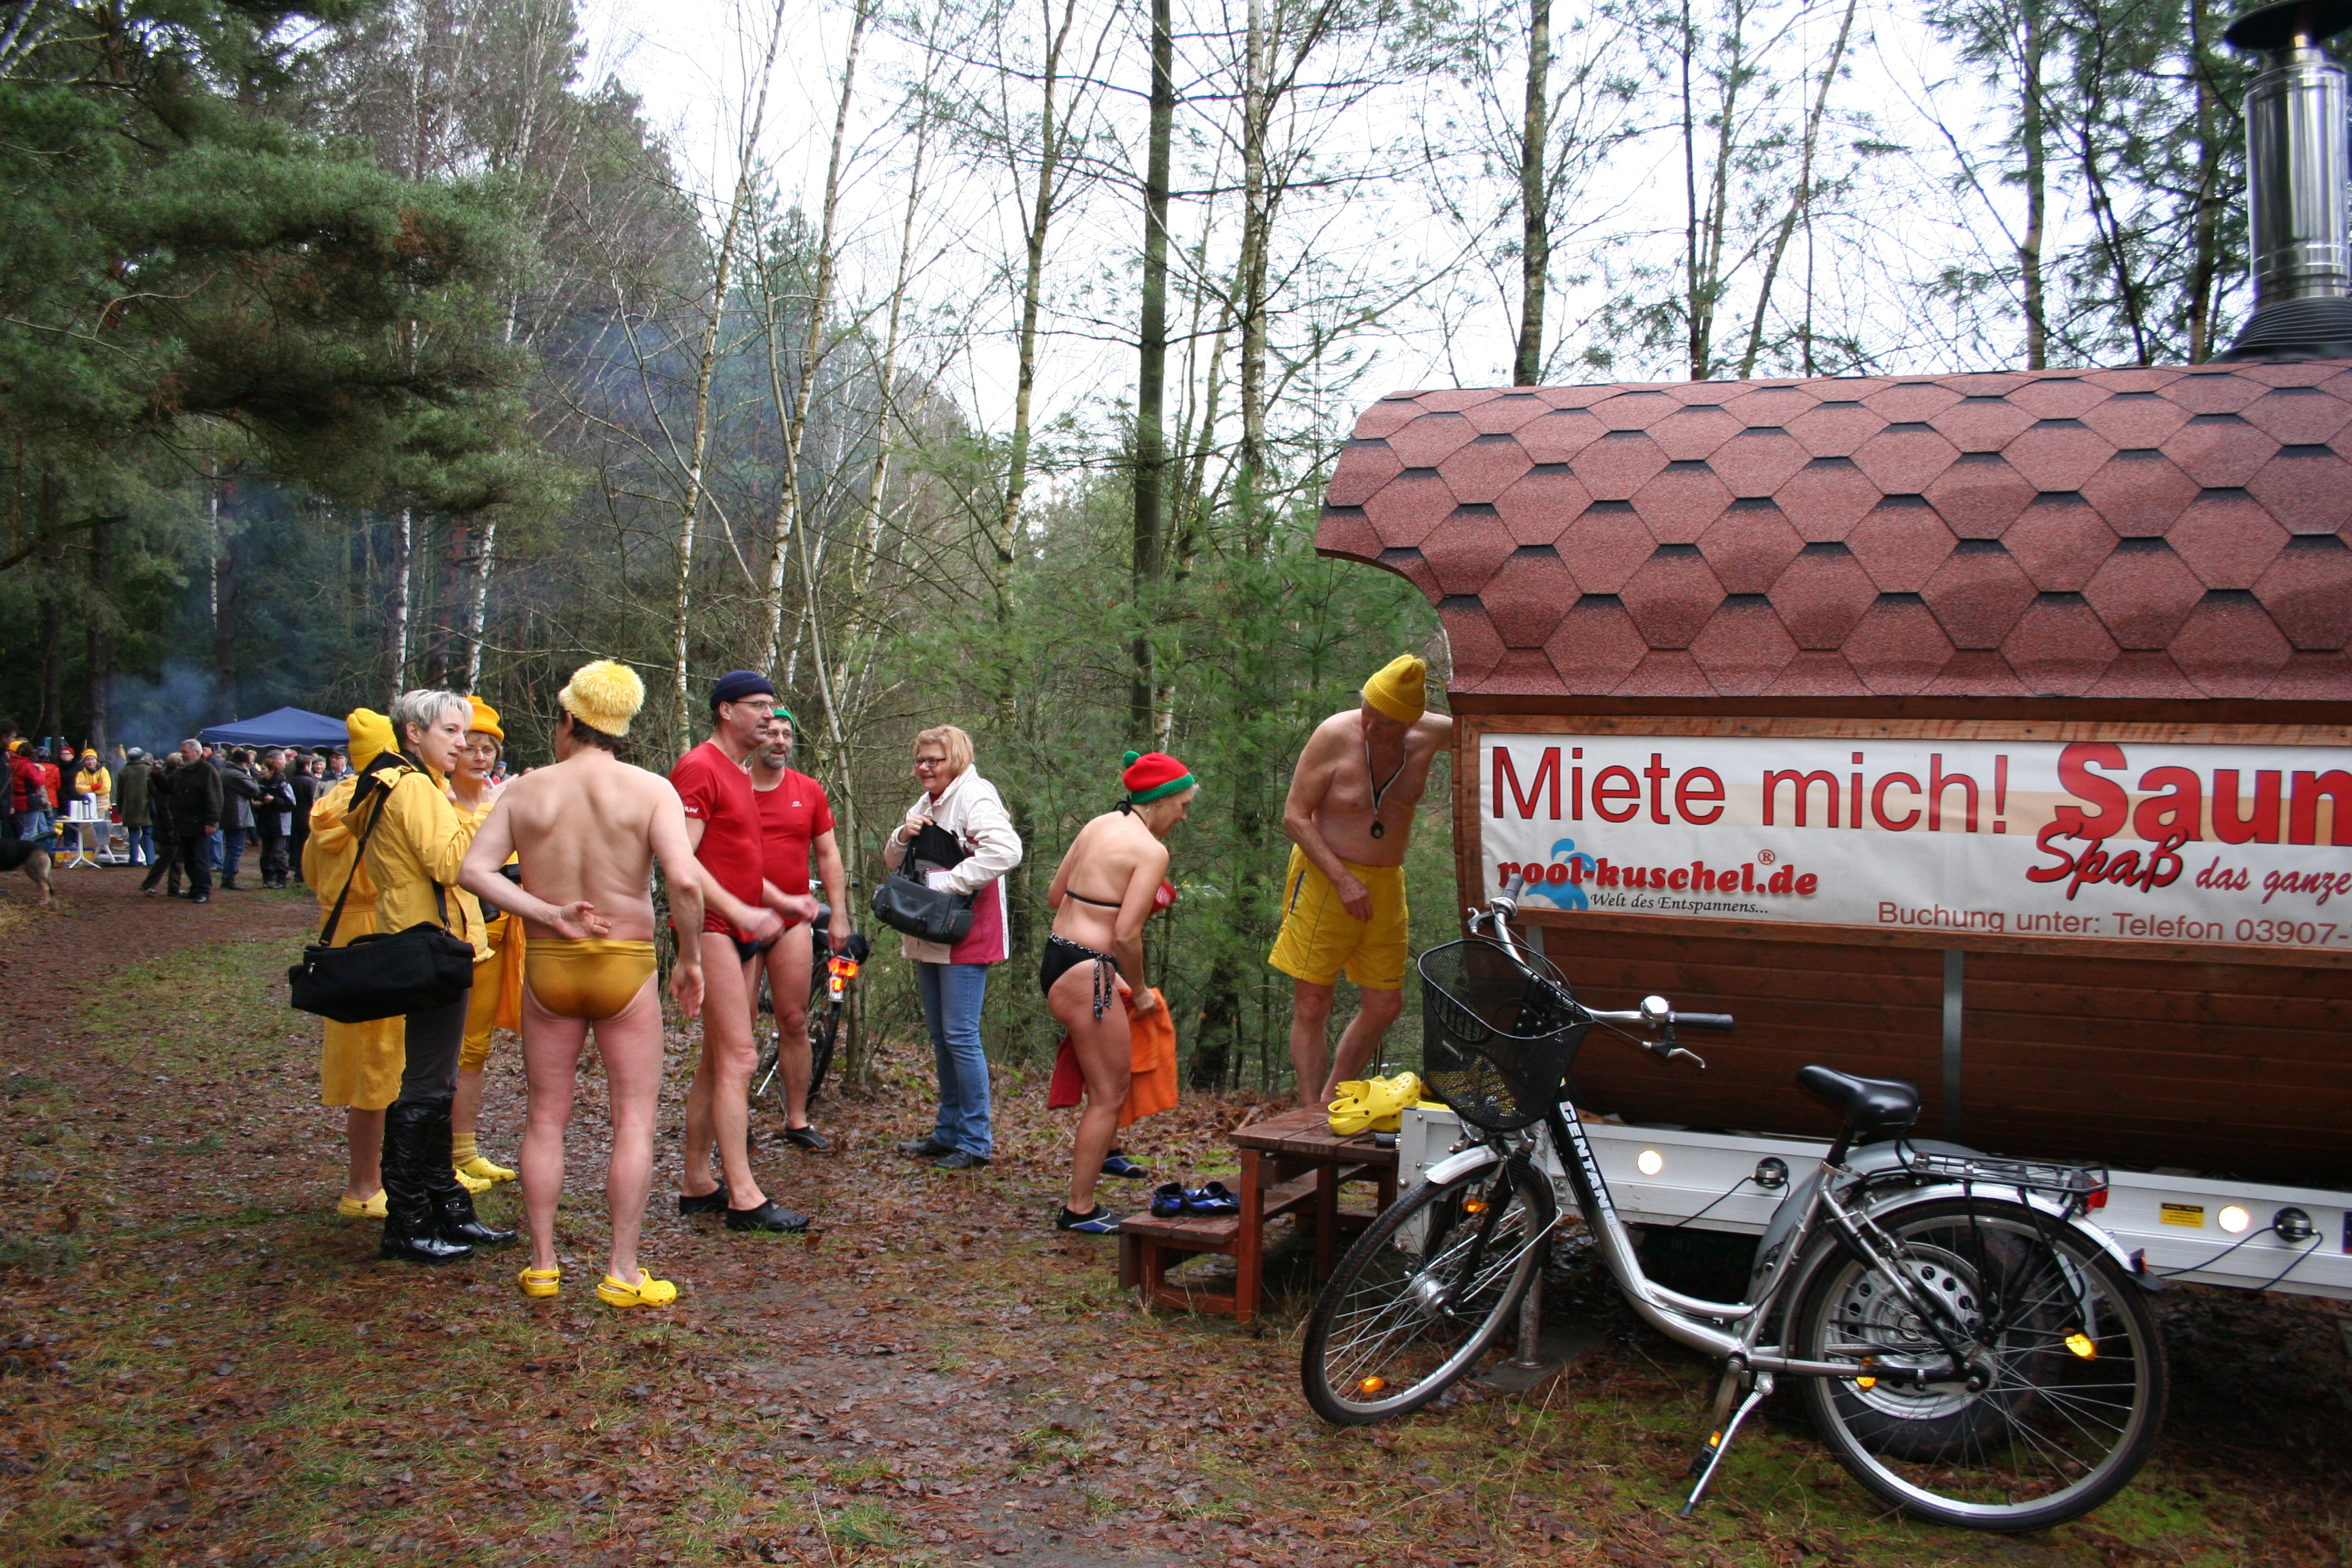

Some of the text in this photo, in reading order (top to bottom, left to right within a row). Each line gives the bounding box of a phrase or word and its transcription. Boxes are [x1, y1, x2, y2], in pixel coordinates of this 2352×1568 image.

[1492, 746, 1725, 826] Miete
[1762, 752, 2008, 834] mich!
[1590, 892, 1769, 914] Welt des Entspannens...
[2025, 819, 2352, 906] Spaß das ganze
[1878, 901, 2352, 945] Buchung unter: Telefon 03907-
[1559, 1100, 1617, 1226] CENTANO
